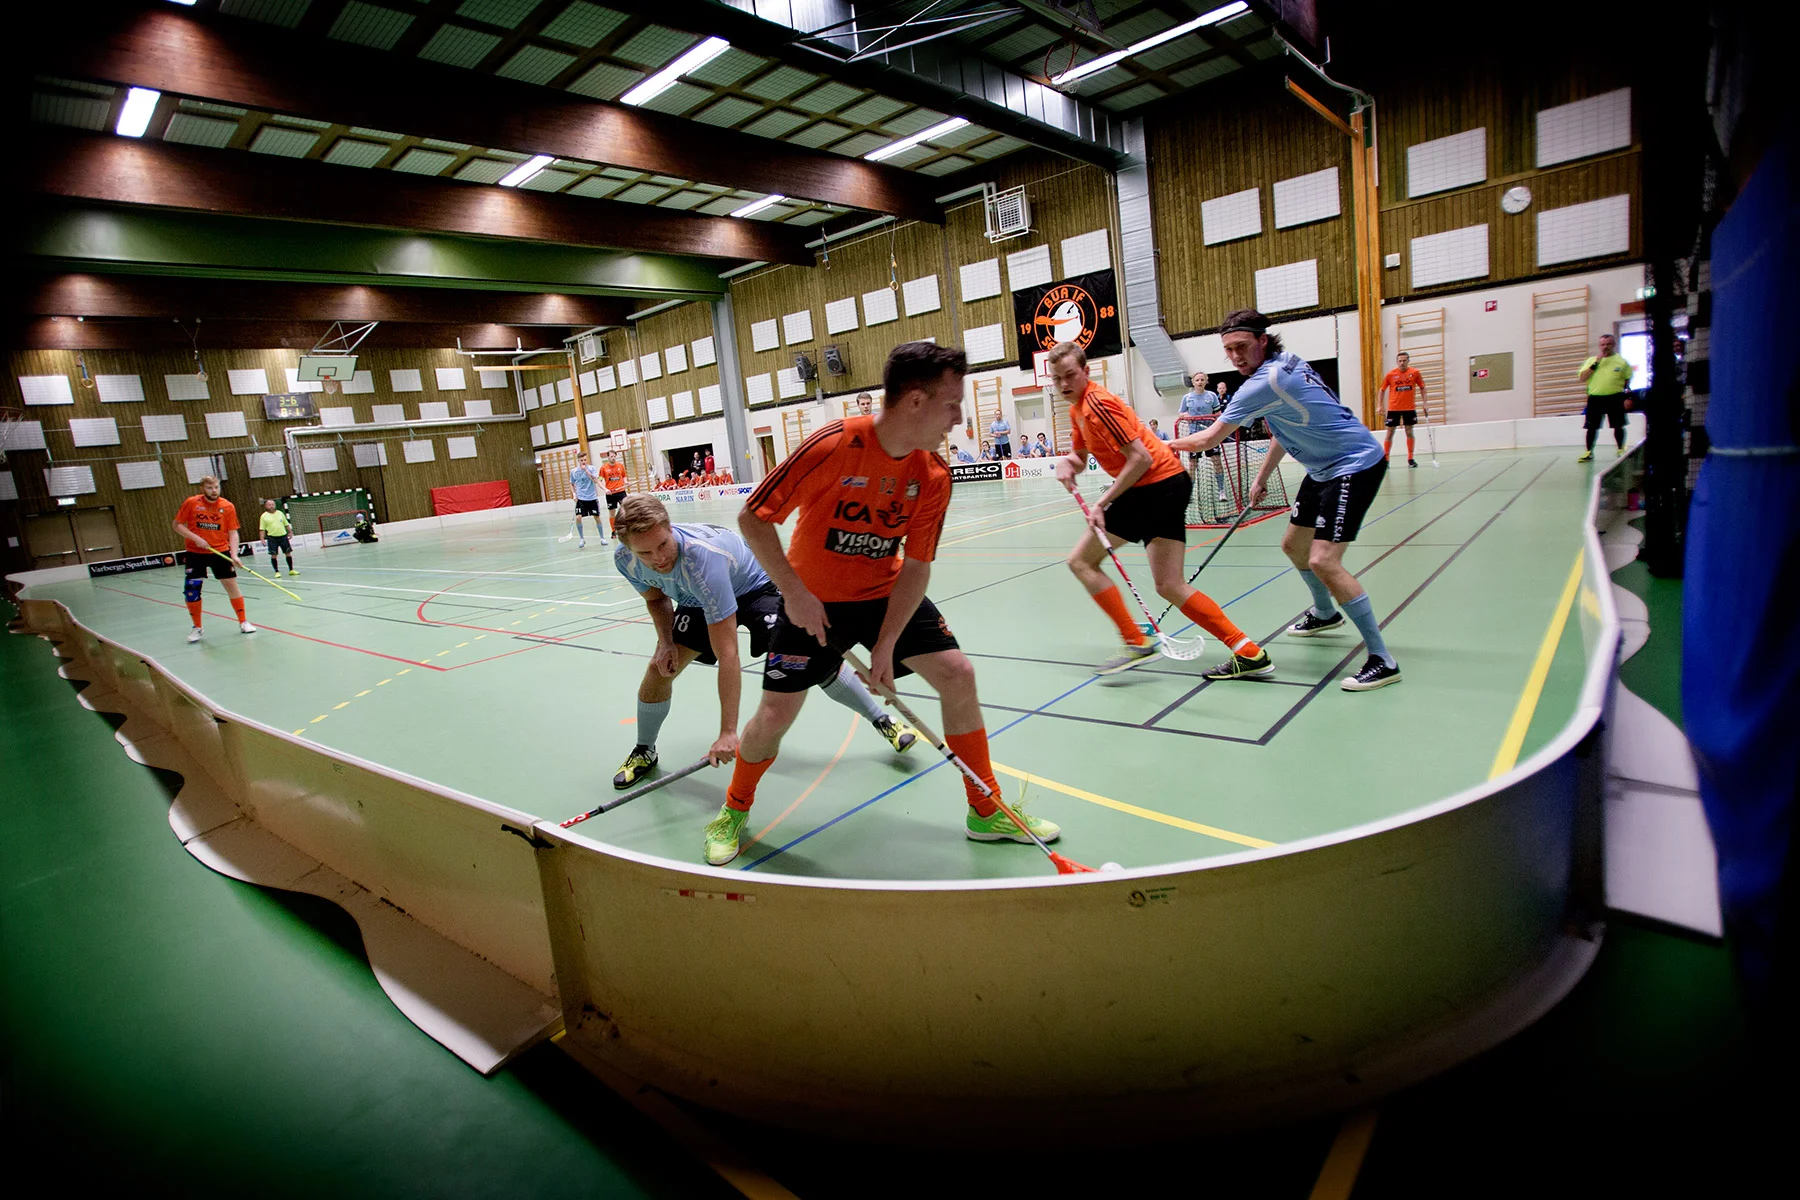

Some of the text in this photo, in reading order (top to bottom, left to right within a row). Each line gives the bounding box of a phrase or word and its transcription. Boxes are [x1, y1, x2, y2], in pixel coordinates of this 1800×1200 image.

[1044, 287, 1086, 309] BUA IF
[1099, 305, 1115, 319] 88
[1020, 323, 1032, 335] 19
[951, 465, 999, 475] REKO
[1005, 467, 1042, 478] JH Bygg
[880, 477, 897, 495] 12
[834, 500, 872, 524] ICA
[837, 531, 895, 551] VISION
[91, 558, 161, 574] Varbergs Sparbank
[672, 613, 691, 633] 18
